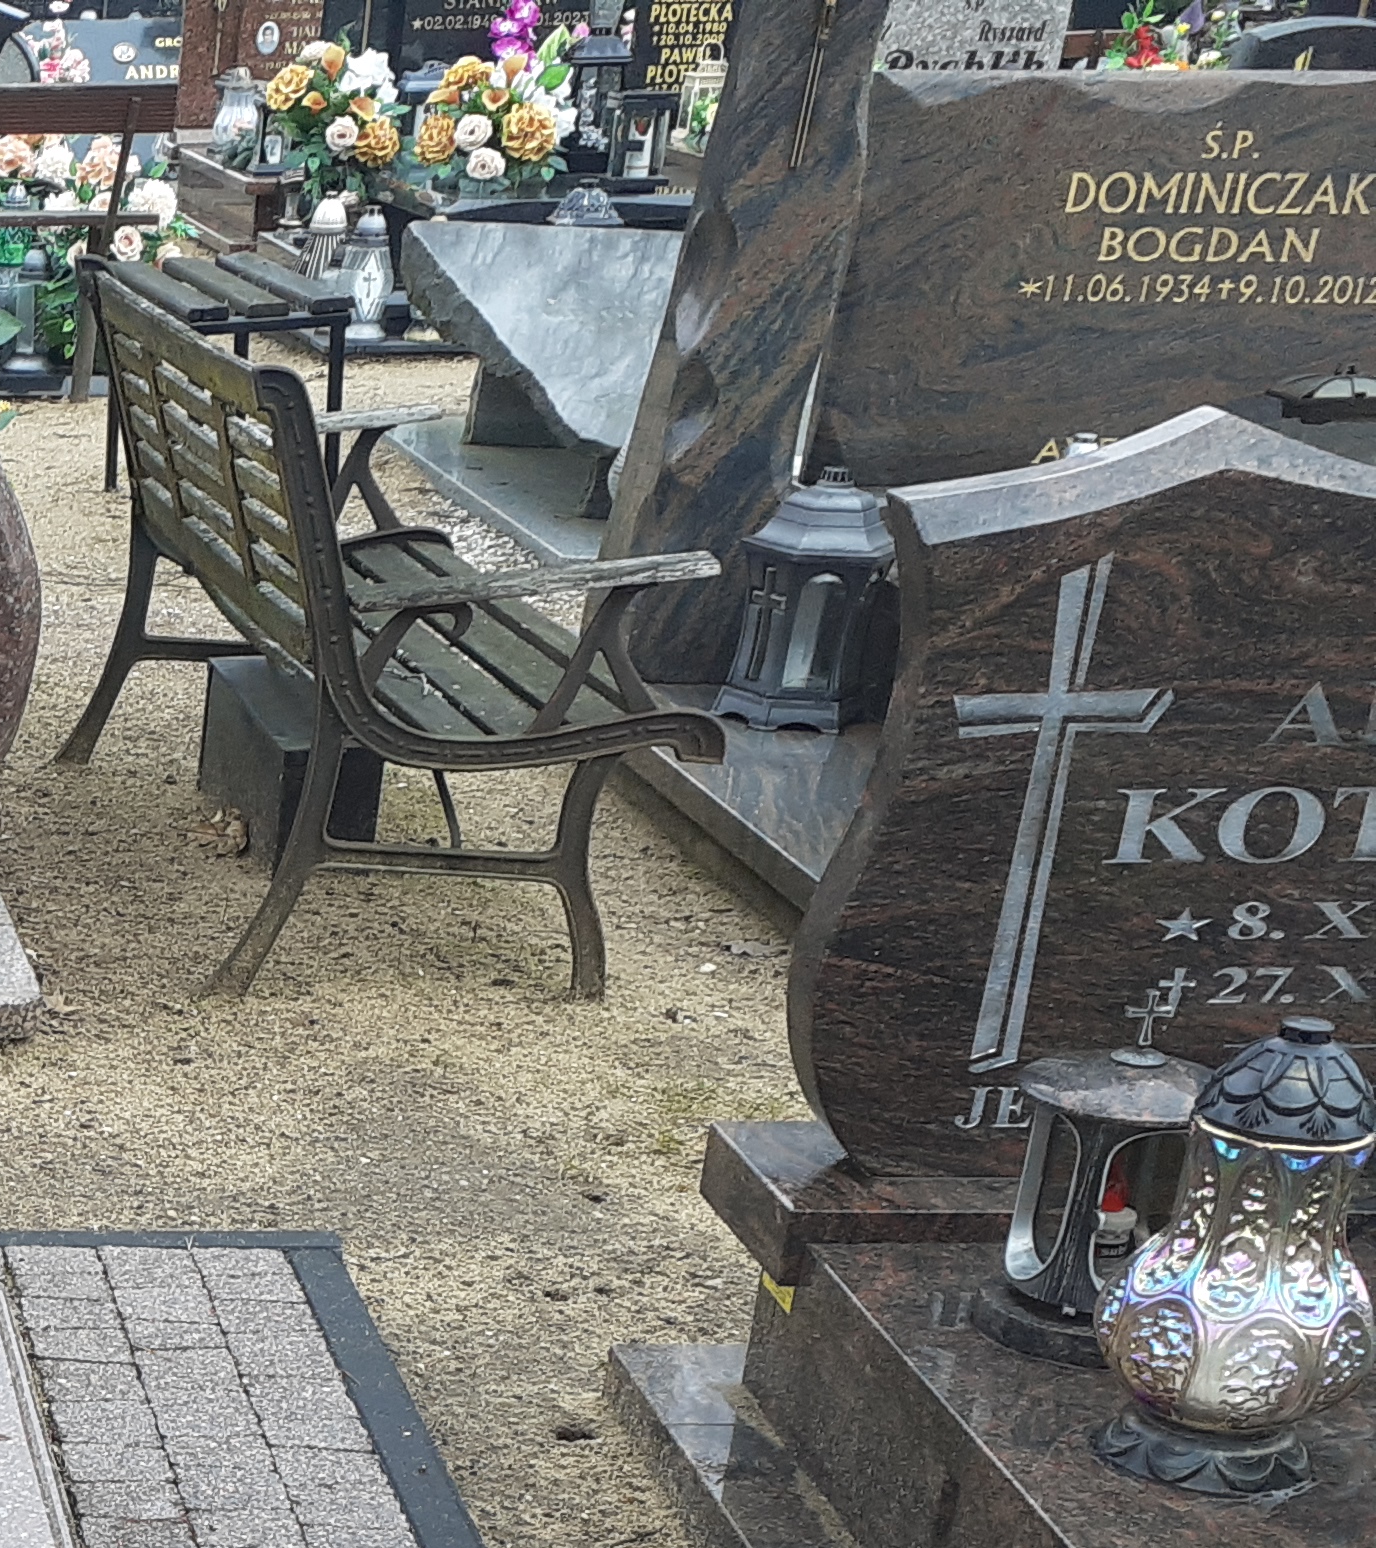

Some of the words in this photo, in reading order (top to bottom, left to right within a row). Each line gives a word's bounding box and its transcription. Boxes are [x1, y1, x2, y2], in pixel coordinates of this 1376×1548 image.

[648, 2, 734, 23] PŁOTECKA
[662, 21, 728, 34] 10.04.1980
[977, 19, 1049, 43] Ryszard
[1201, 120, 1261, 160] Ś.P.
[1064, 171, 1376, 216] DOMINICZAK
[1097, 226, 1321, 263] BOGDAN
